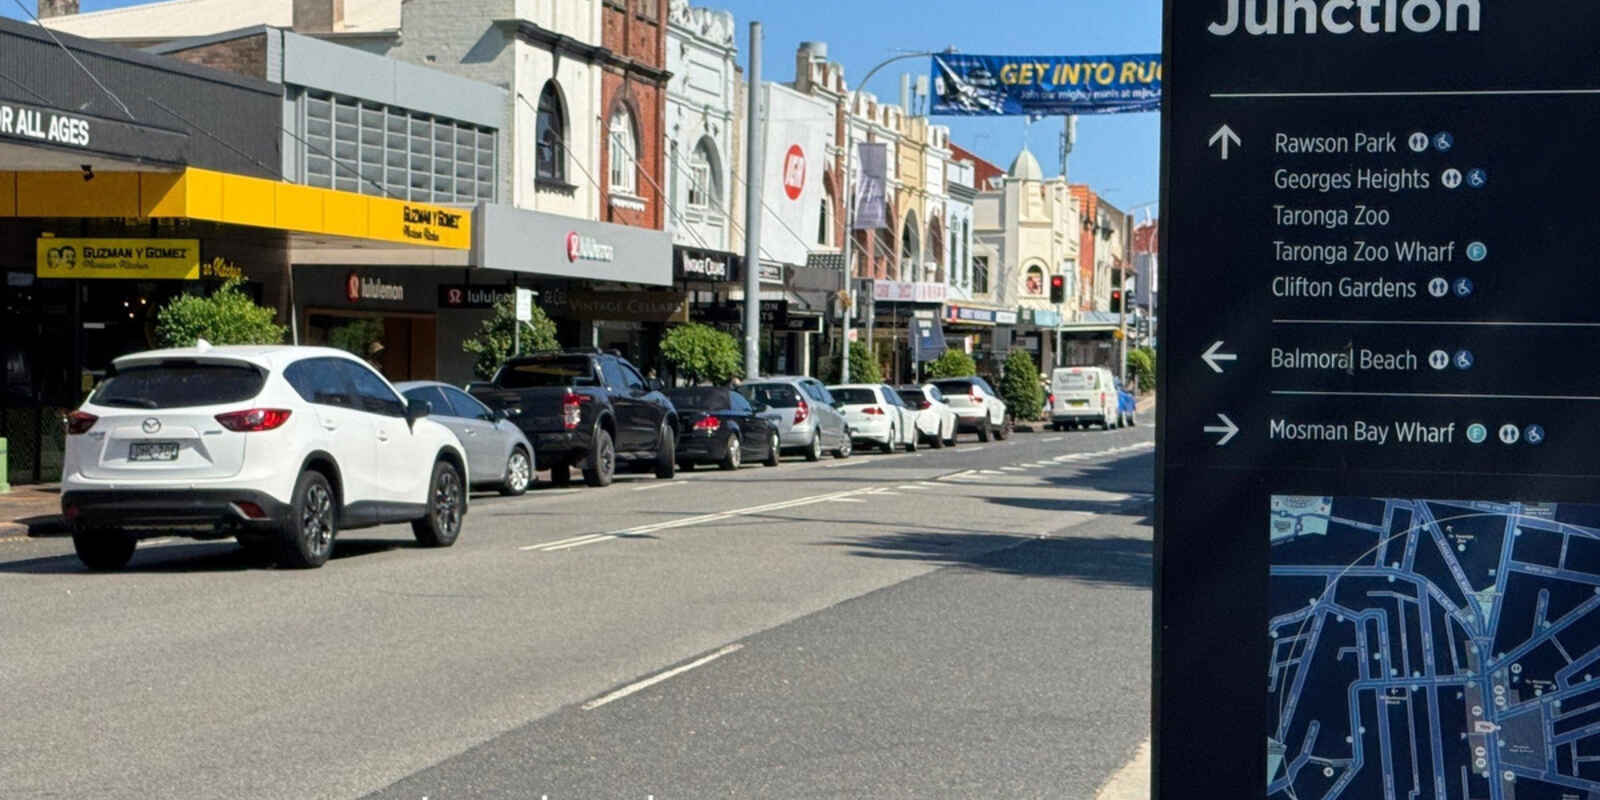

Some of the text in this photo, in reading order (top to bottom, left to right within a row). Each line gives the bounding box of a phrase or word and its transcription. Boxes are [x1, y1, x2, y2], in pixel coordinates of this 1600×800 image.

[1207, 0, 1481, 36] Junction
[1000, 63, 1050, 85] GET
[1052, 62, 1115, 85] INTO
[15, 108, 46, 138] ALL
[48, 115, 89, 146] AGES
[1275, 131, 1396, 153] Rawson Park
[1274, 167, 1430, 193] Georges Heights
[1273, 204, 1390, 229] Taronga Zoo
[83, 247, 186, 259] GUZMAN Y GOMEZ
[1273, 240, 1348, 265] Taronga
[1353, 240, 1389, 262] Zoo
[1394, 240, 1455, 262] Wharf
[361, 277, 404, 300] lululemon
[1272, 276, 1417, 298] Clifton Gardens
[1271, 347, 1417, 370] Balmoral Beach
[1269, 418, 1348, 441] Mosman
[1354, 420, 1390, 445] Bay
[1394, 421, 1456, 443] Wharf
